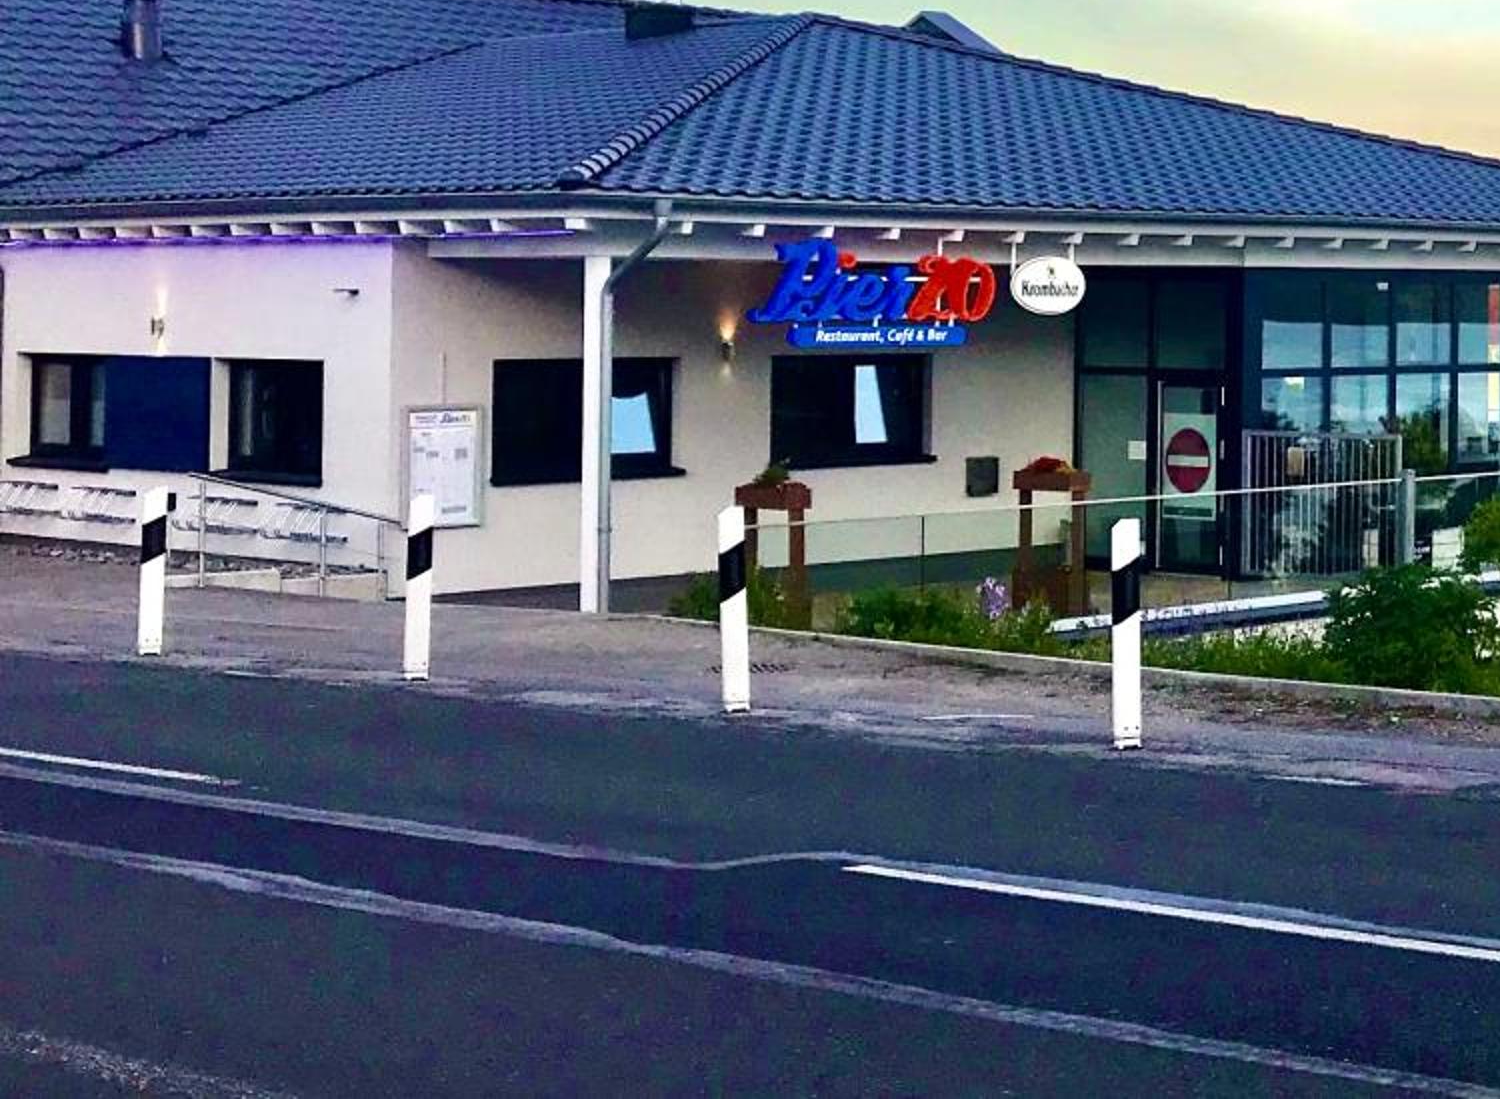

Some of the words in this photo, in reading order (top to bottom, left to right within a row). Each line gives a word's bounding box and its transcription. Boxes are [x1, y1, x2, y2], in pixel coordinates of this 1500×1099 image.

[815, 330, 885, 343] Restaurant,
[887, 328, 914, 345] Café
[916, 330, 924, 341] &
[927, 329, 948, 341] Bar
